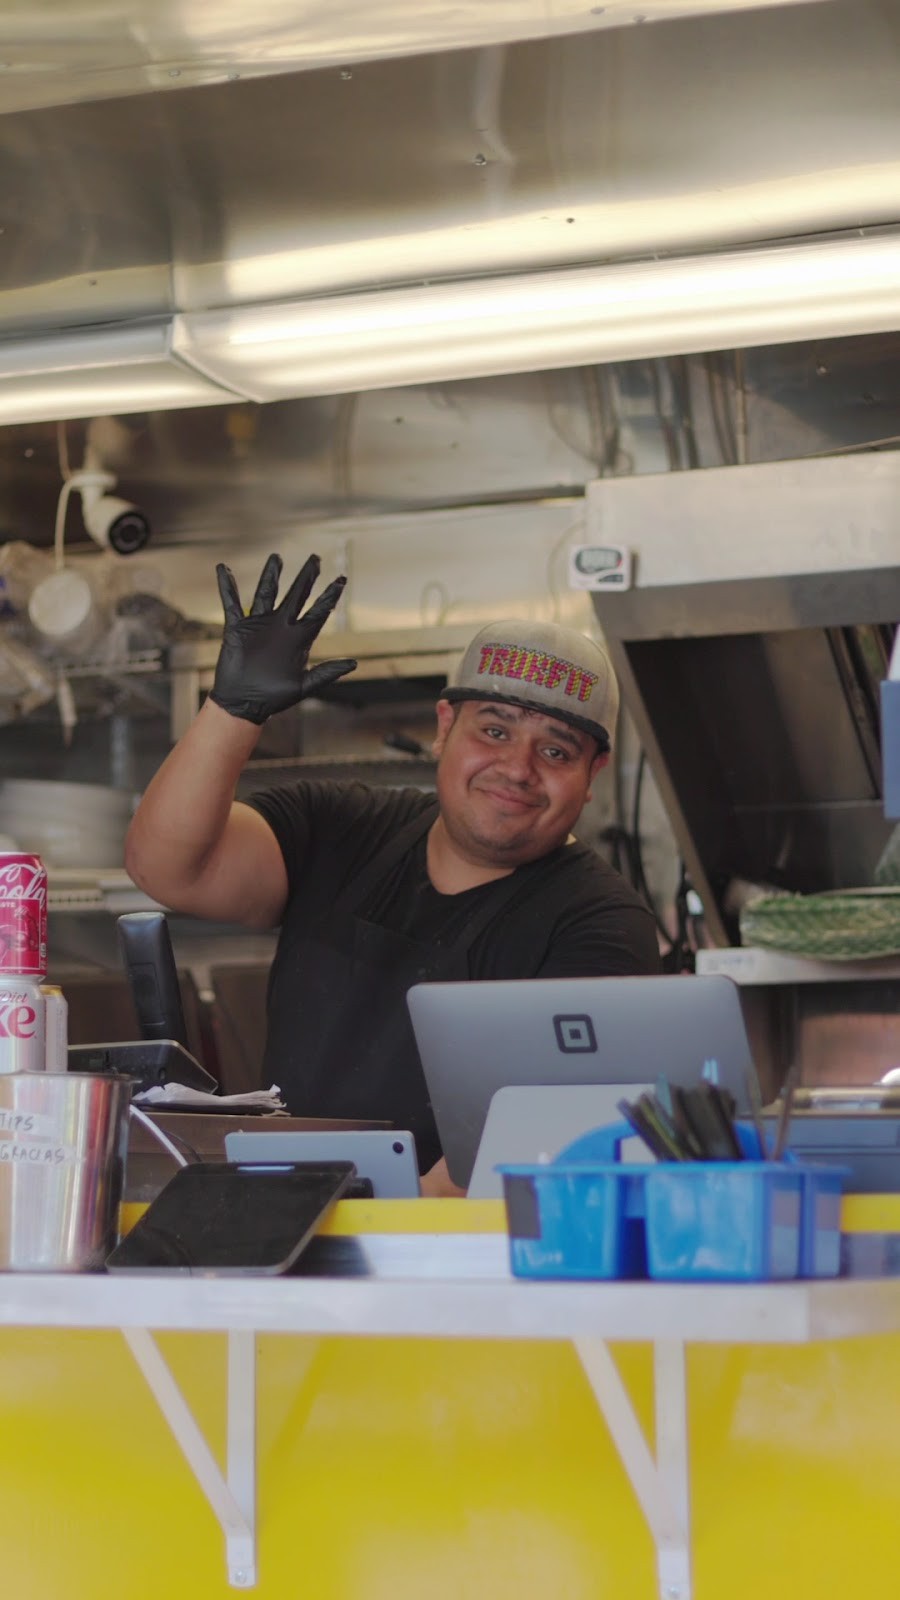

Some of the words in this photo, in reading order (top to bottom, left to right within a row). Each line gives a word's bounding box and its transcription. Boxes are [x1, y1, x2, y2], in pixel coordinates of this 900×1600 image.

[477, 642, 599, 702] TRUKFIT
[0, 1112, 34, 1131] TIPS
[0, 1143, 65, 1166] GRACIAS
